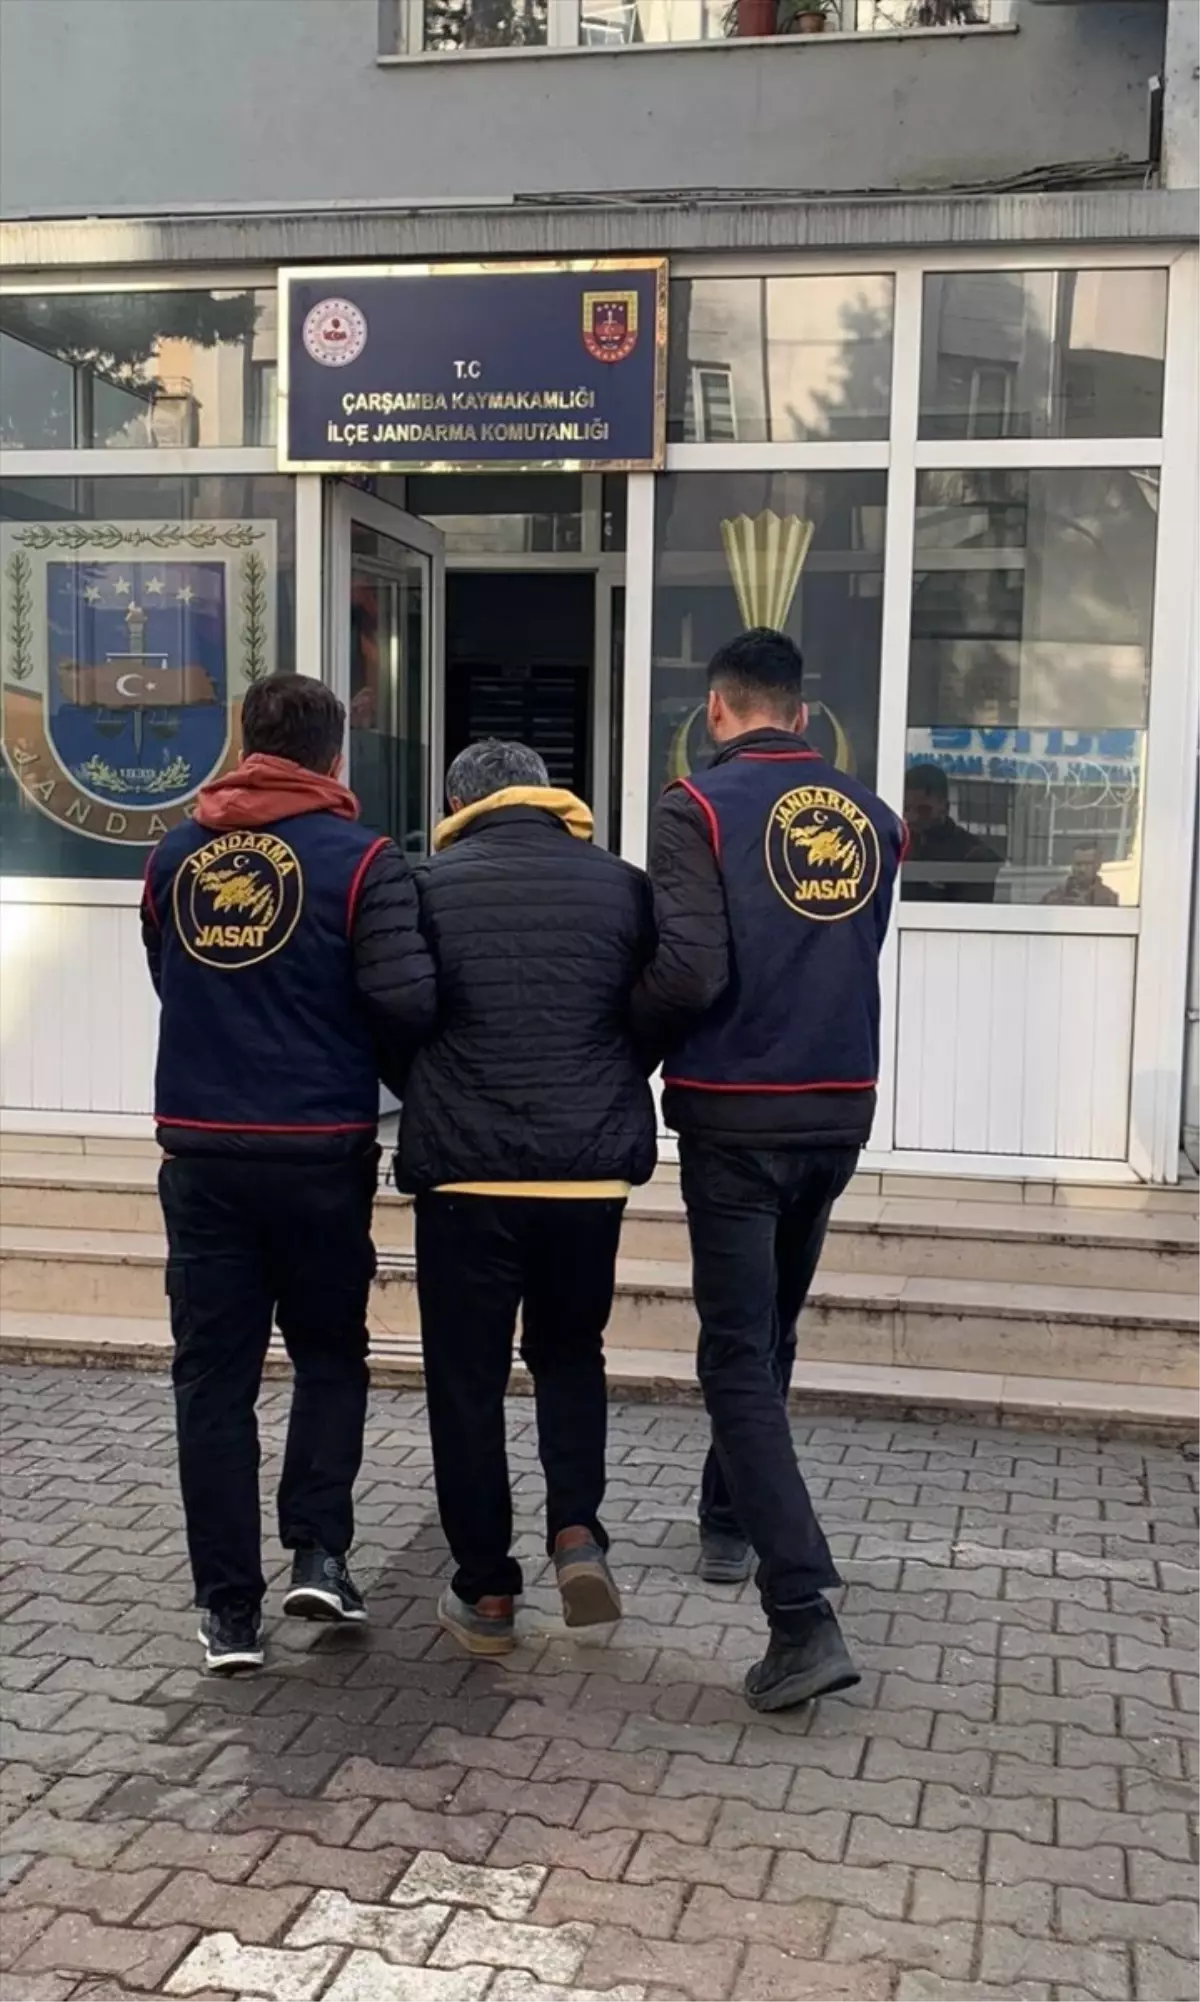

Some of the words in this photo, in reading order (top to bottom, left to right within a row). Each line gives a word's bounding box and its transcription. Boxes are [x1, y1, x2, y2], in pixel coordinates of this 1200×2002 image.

[453, 360, 481, 379] T.C
[342, 392, 448, 416] ÇARŞAMBA
[451, 386, 595, 411] KAYMAKAMLIĞI
[327, 420, 369, 446] İLÇE
[372, 423, 477, 442] JANDARMA
[481, 418, 609, 441] KOMUTANLIĞI
[775, 790, 867, 833] JANDARMA
[188, 834, 295, 877] JANDARMA
[795, 879, 860, 900] JASAT
[194, 924, 269, 948] JASAT
